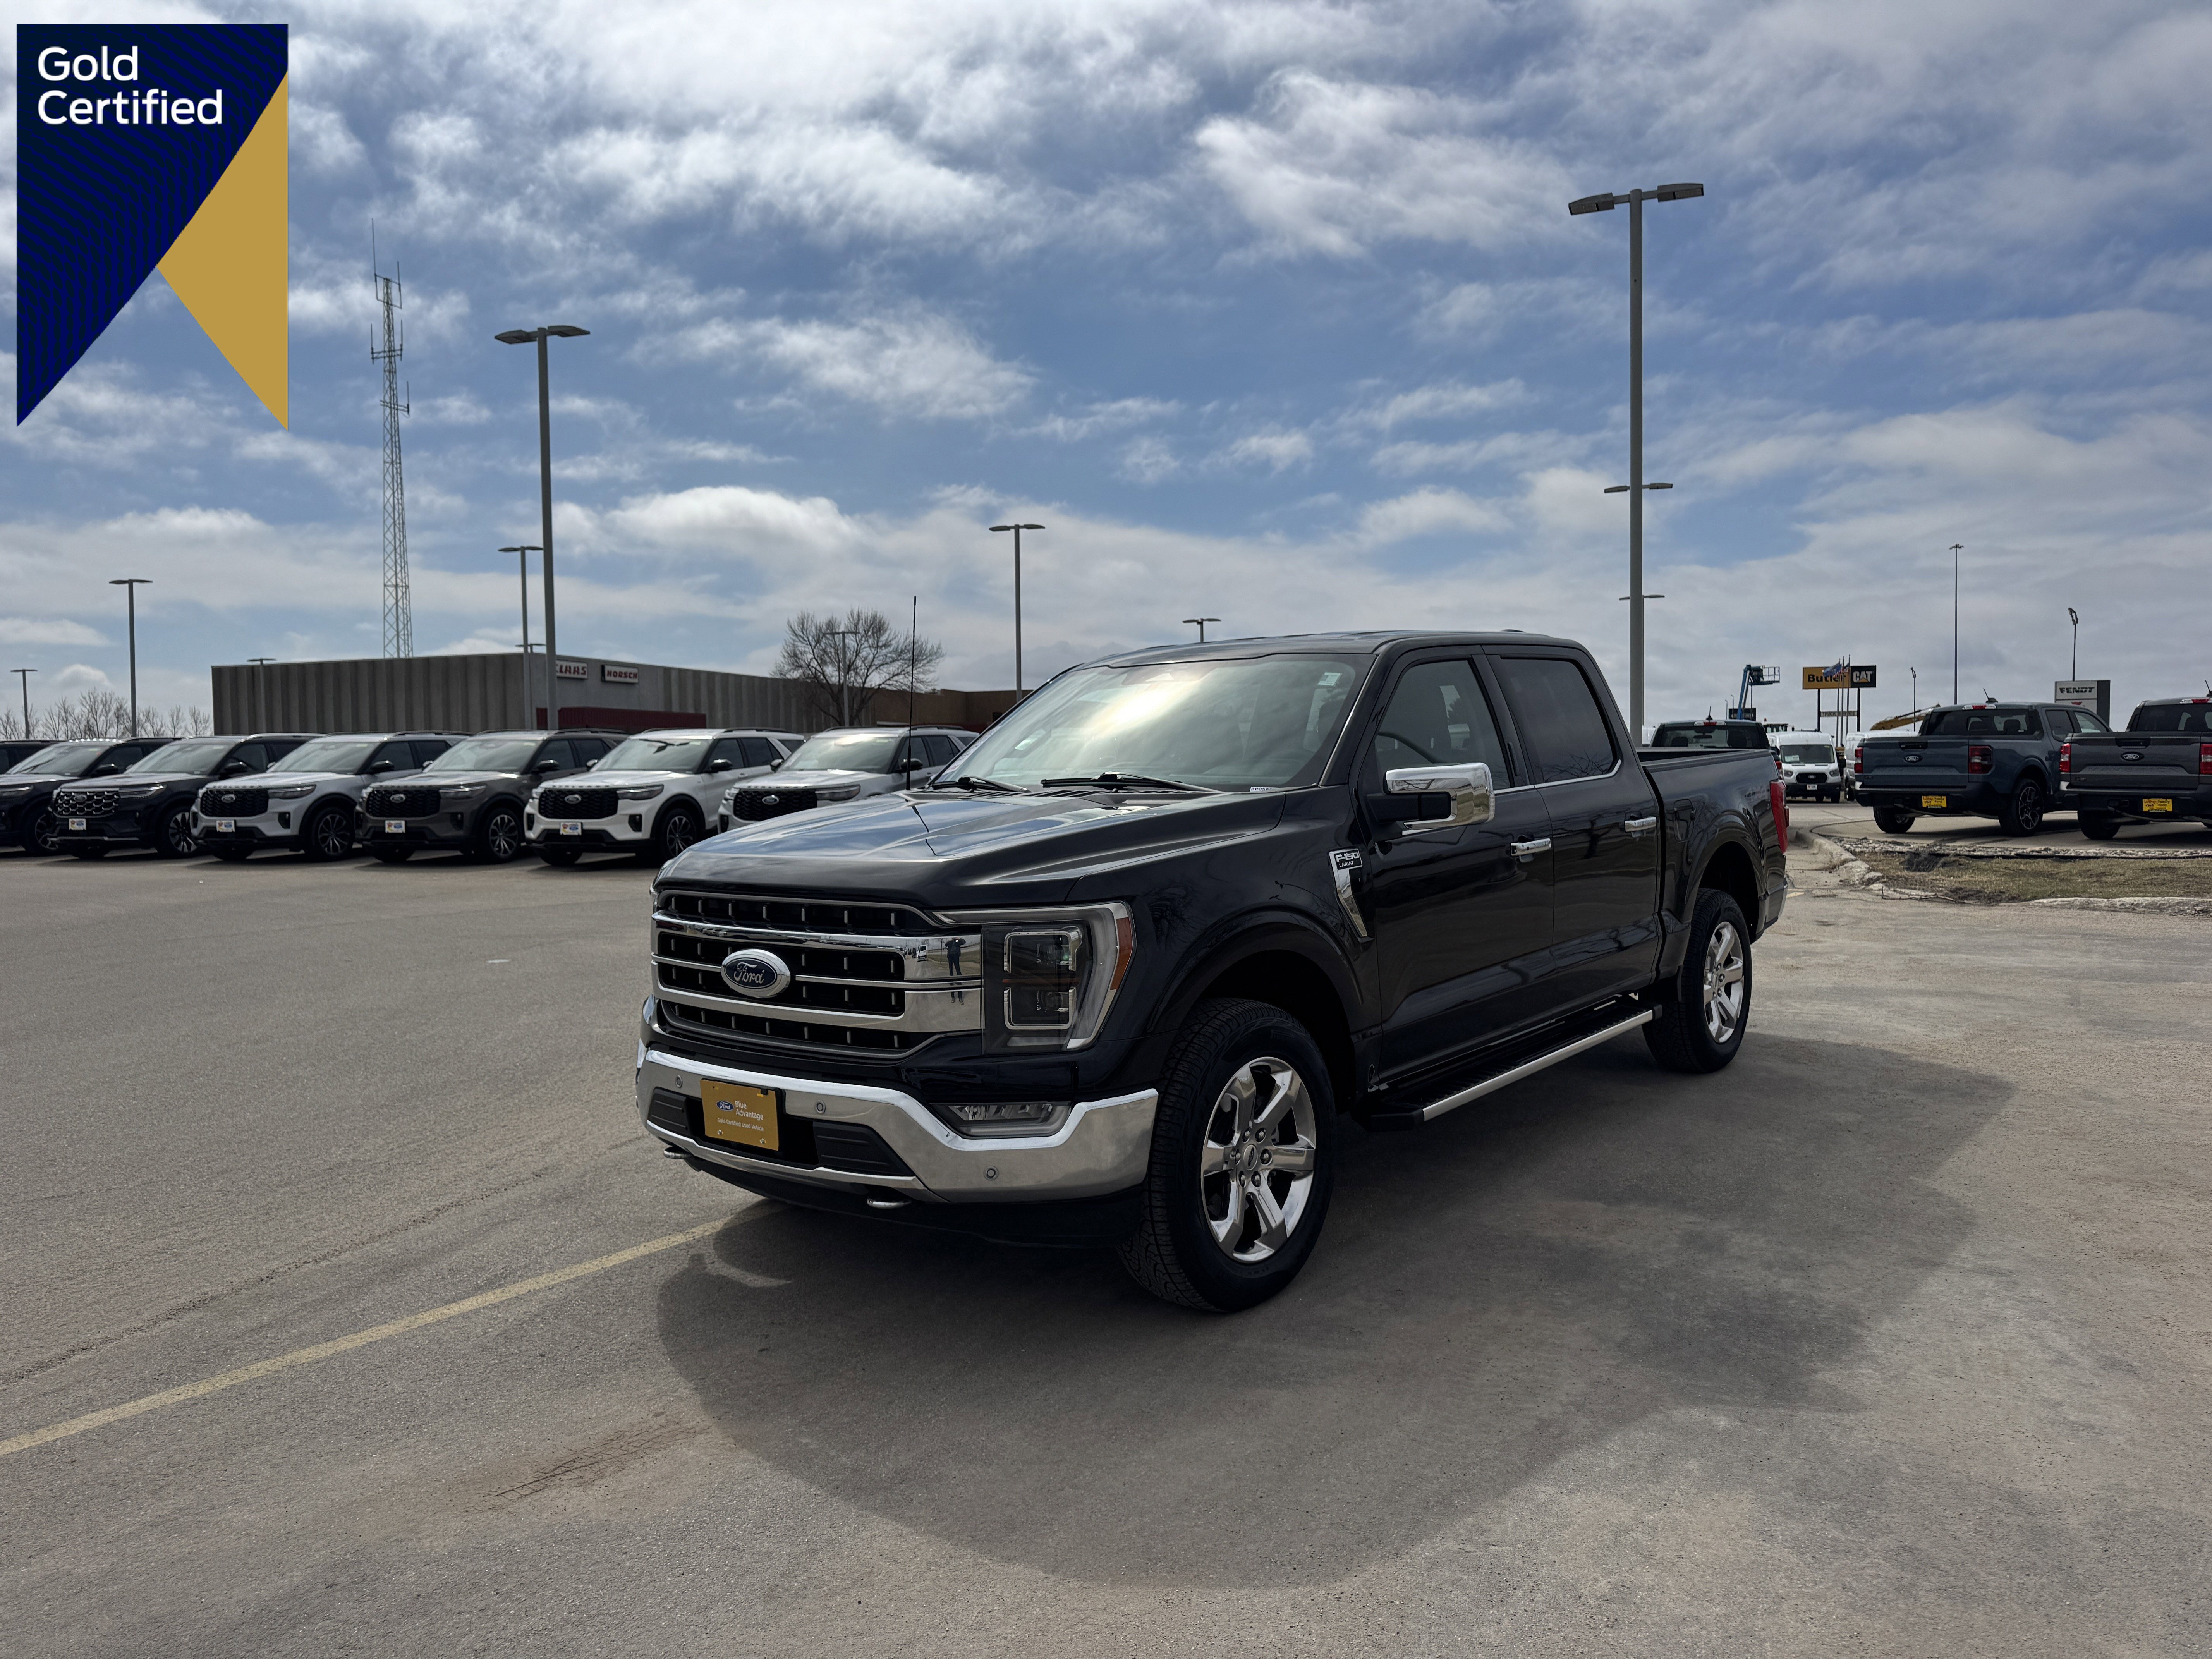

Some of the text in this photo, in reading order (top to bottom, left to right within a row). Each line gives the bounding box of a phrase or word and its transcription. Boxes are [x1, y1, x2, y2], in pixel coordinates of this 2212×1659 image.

[606, 670, 638, 679] HORSCH
[1853, 671, 1872, 683] CAT
[1335, 852, 1360, 862] F-150
[733, 962, 765, 984] Ford
[719, 1101, 747, 1110] Ford Blue
[736, 1109, 764, 1121] Advantage
[751, 1124, 764, 1132] Vehicle
